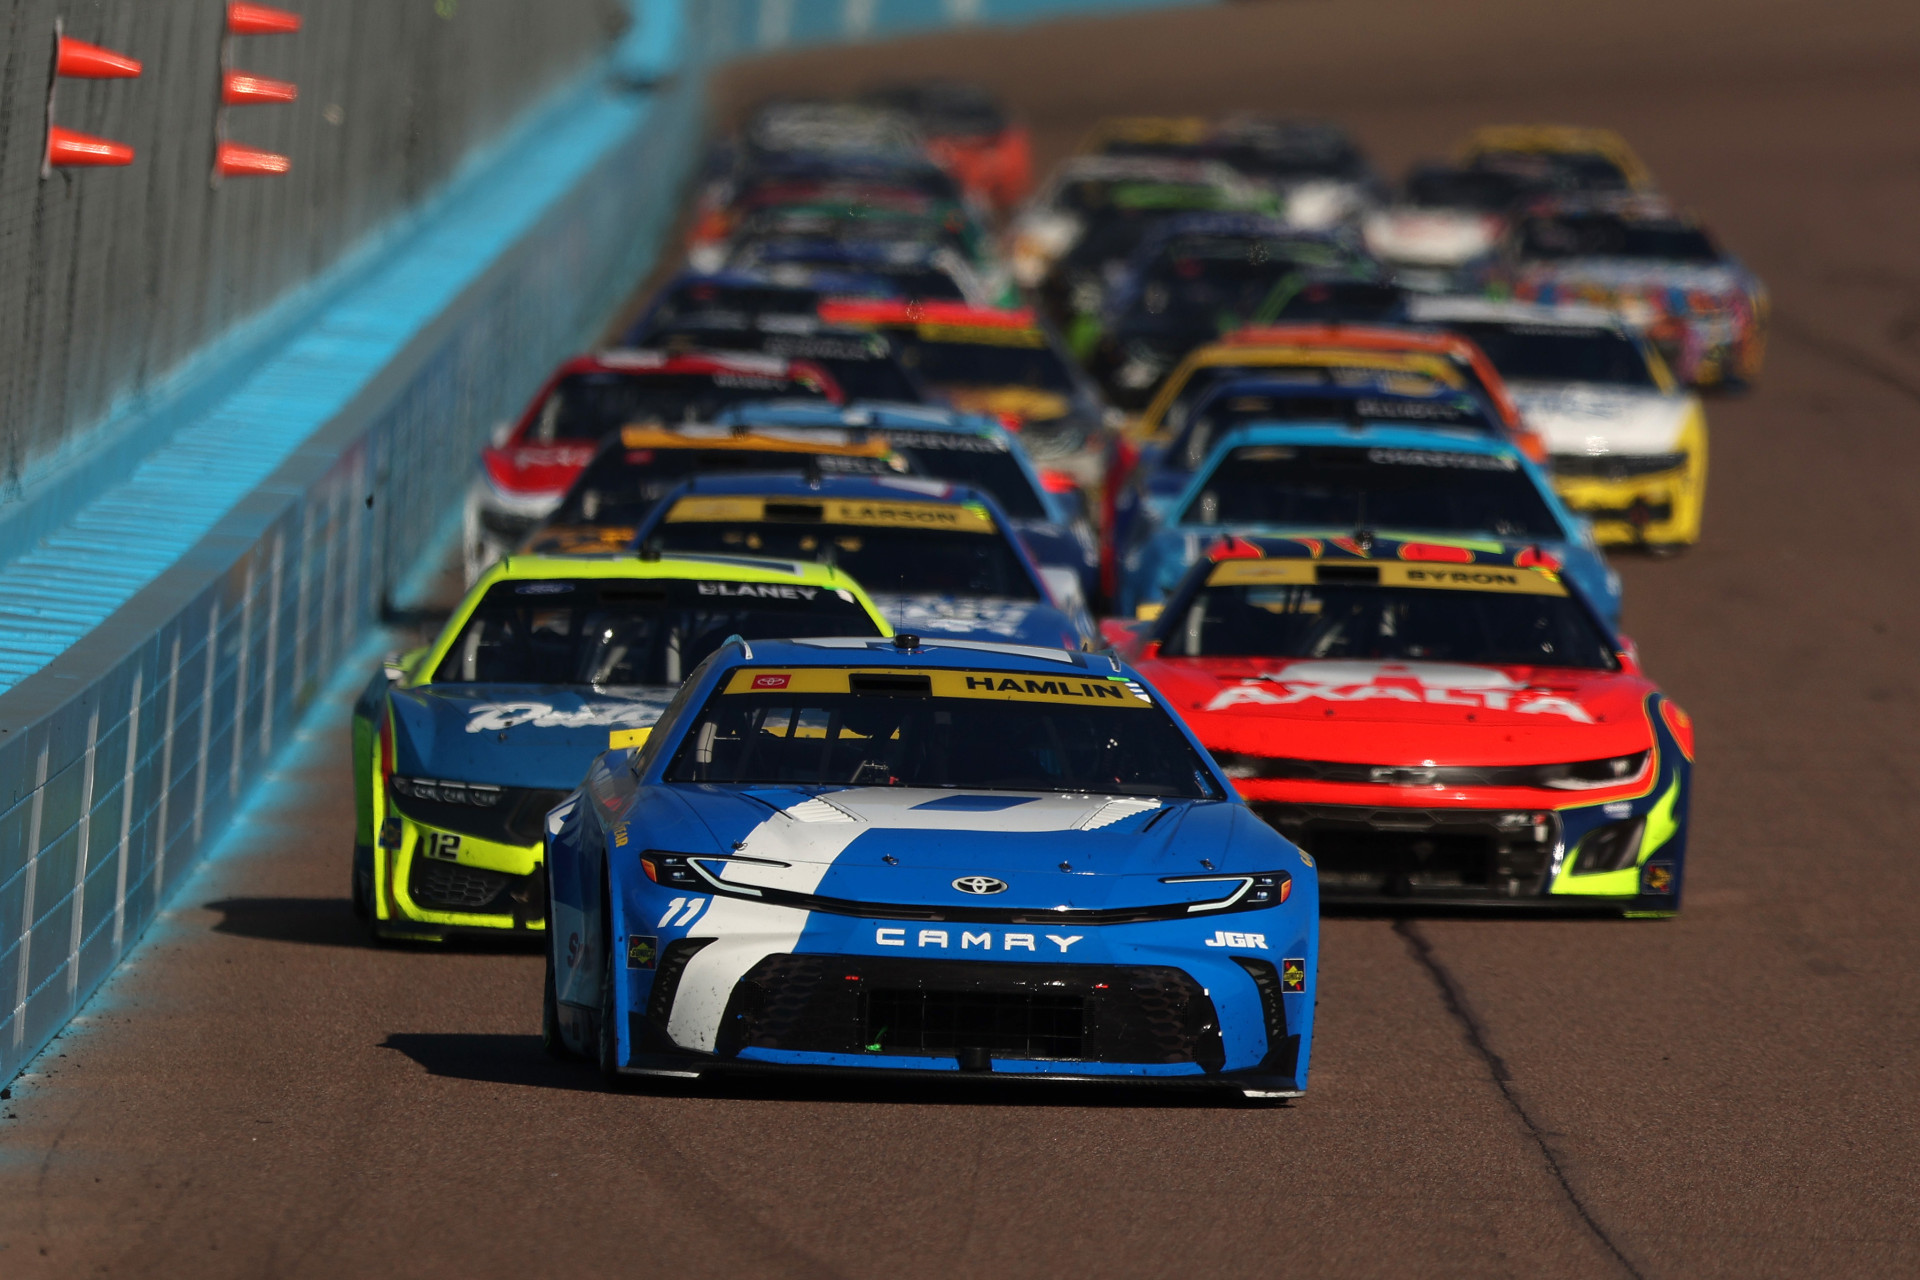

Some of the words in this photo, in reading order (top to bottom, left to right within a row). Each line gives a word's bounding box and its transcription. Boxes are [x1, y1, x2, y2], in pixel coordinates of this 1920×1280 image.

[840, 508, 957, 524] LARSON
[1407, 569, 1518, 585] BYRON
[697, 582, 818, 600] BLANEY
[965, 676, 1124, 699] HAMLIN
[1205, 683, 1596, 725] AXALTA
[429, 833, 461, 860] 12
[657, 897, 706, 929] 11
[876, 928, 1084, 953] CAMRY
[1205, 931, 1269, 950] JGR
